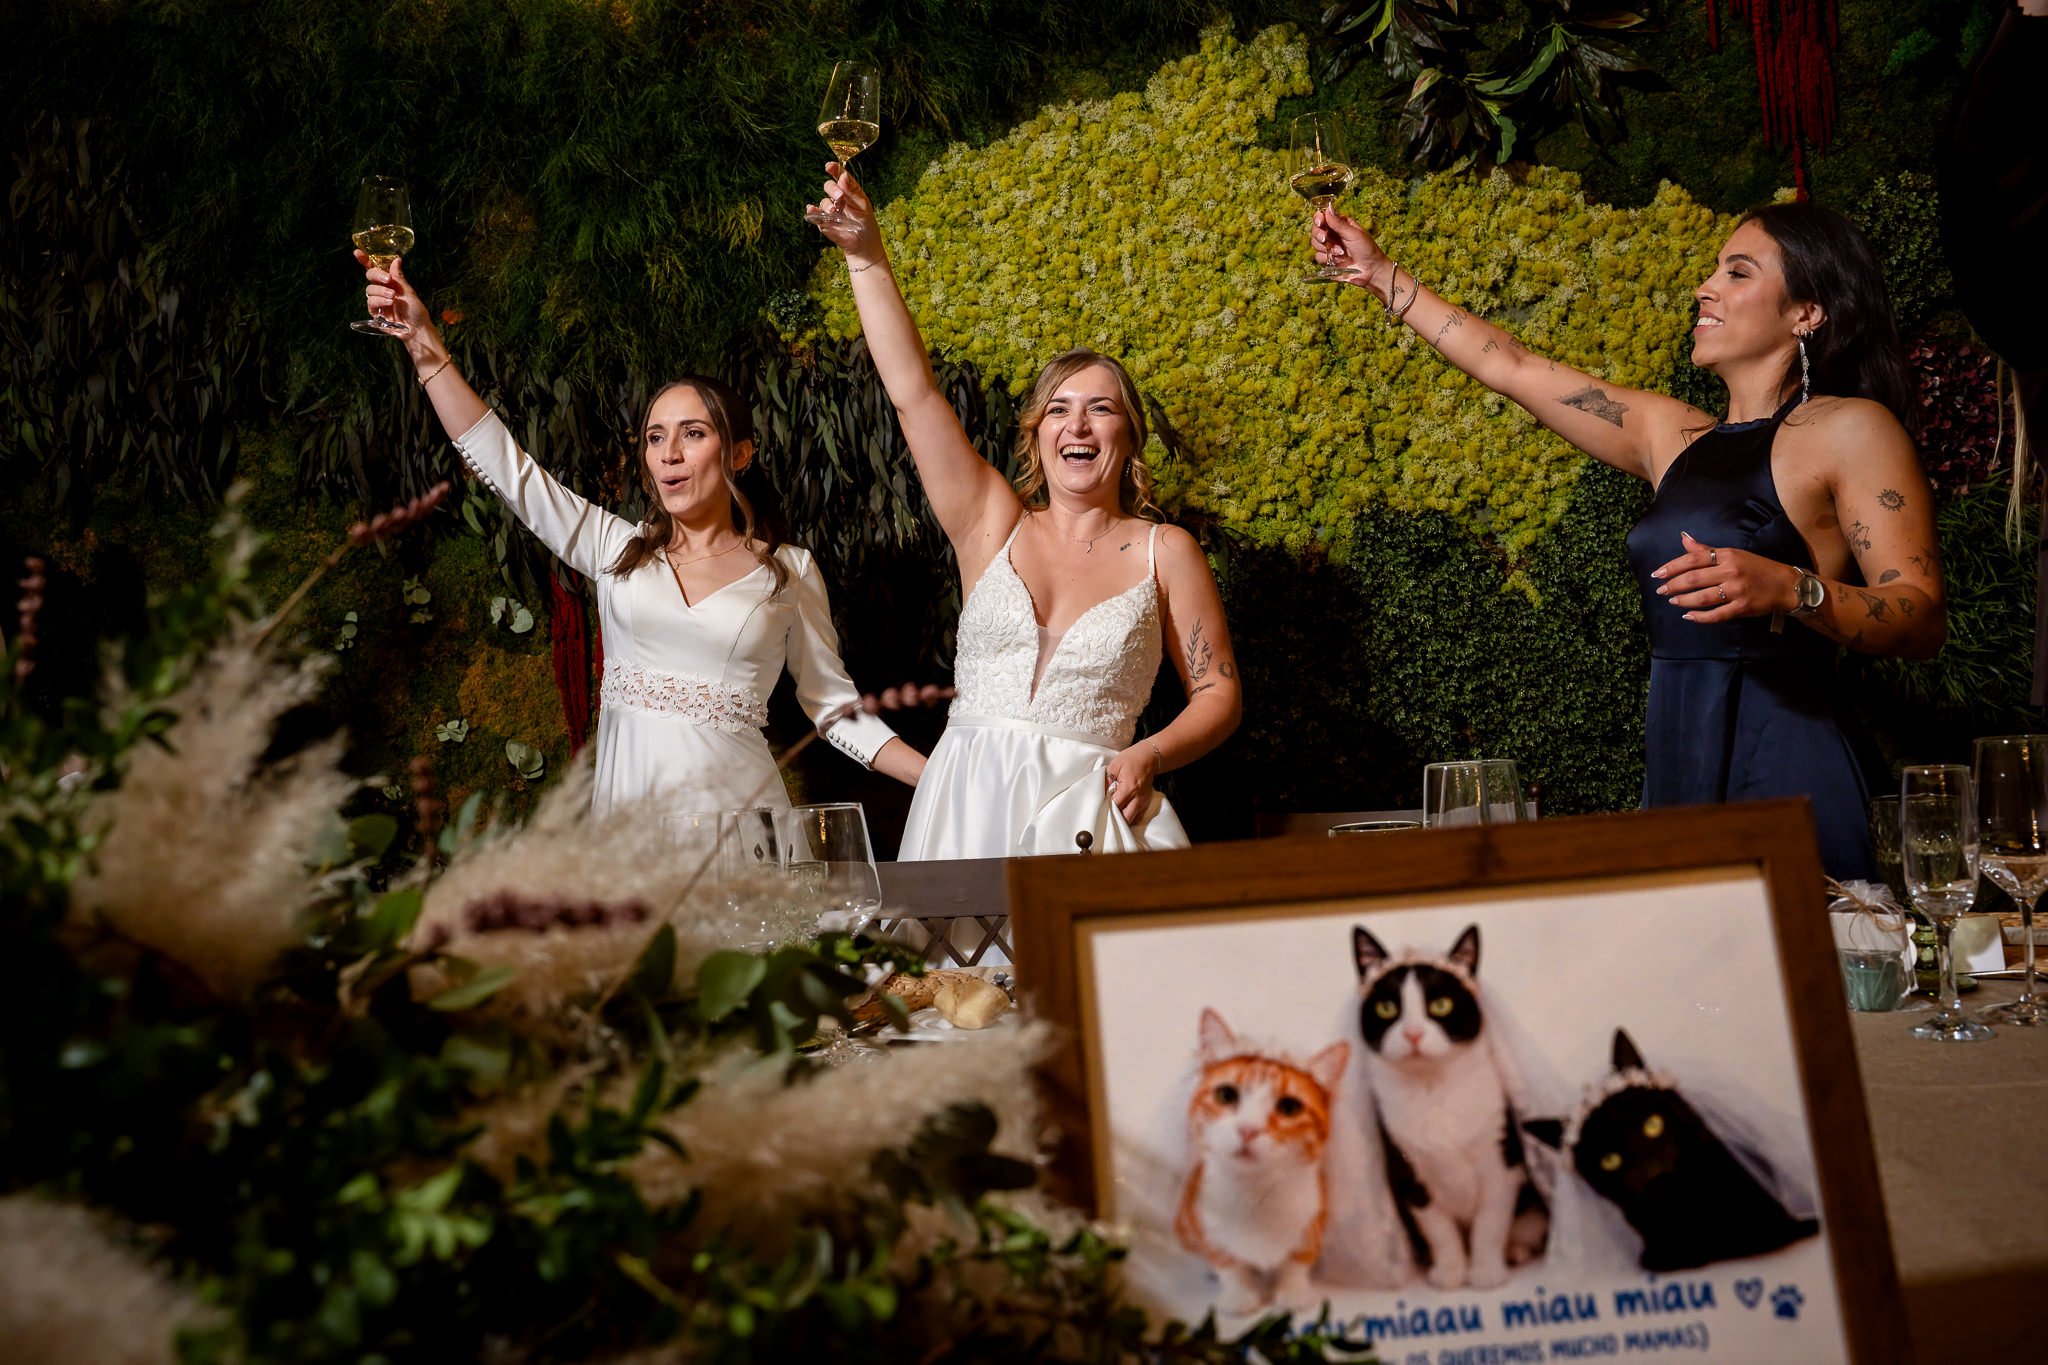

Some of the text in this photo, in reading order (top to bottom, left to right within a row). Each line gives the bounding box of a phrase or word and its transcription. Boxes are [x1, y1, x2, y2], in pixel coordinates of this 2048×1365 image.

[1364, 1300, 1482, 1341] miaau
[1501, 1286, 1597, 1329] miau
[1614, 1273, 1716, 1315] miau
[1438, 1341, 1545, 1365] QUEREMOS
[1551, 1333, 1619, 1358] MUCHO
[1625, 1321, 1709, 1352] MAMAS)
